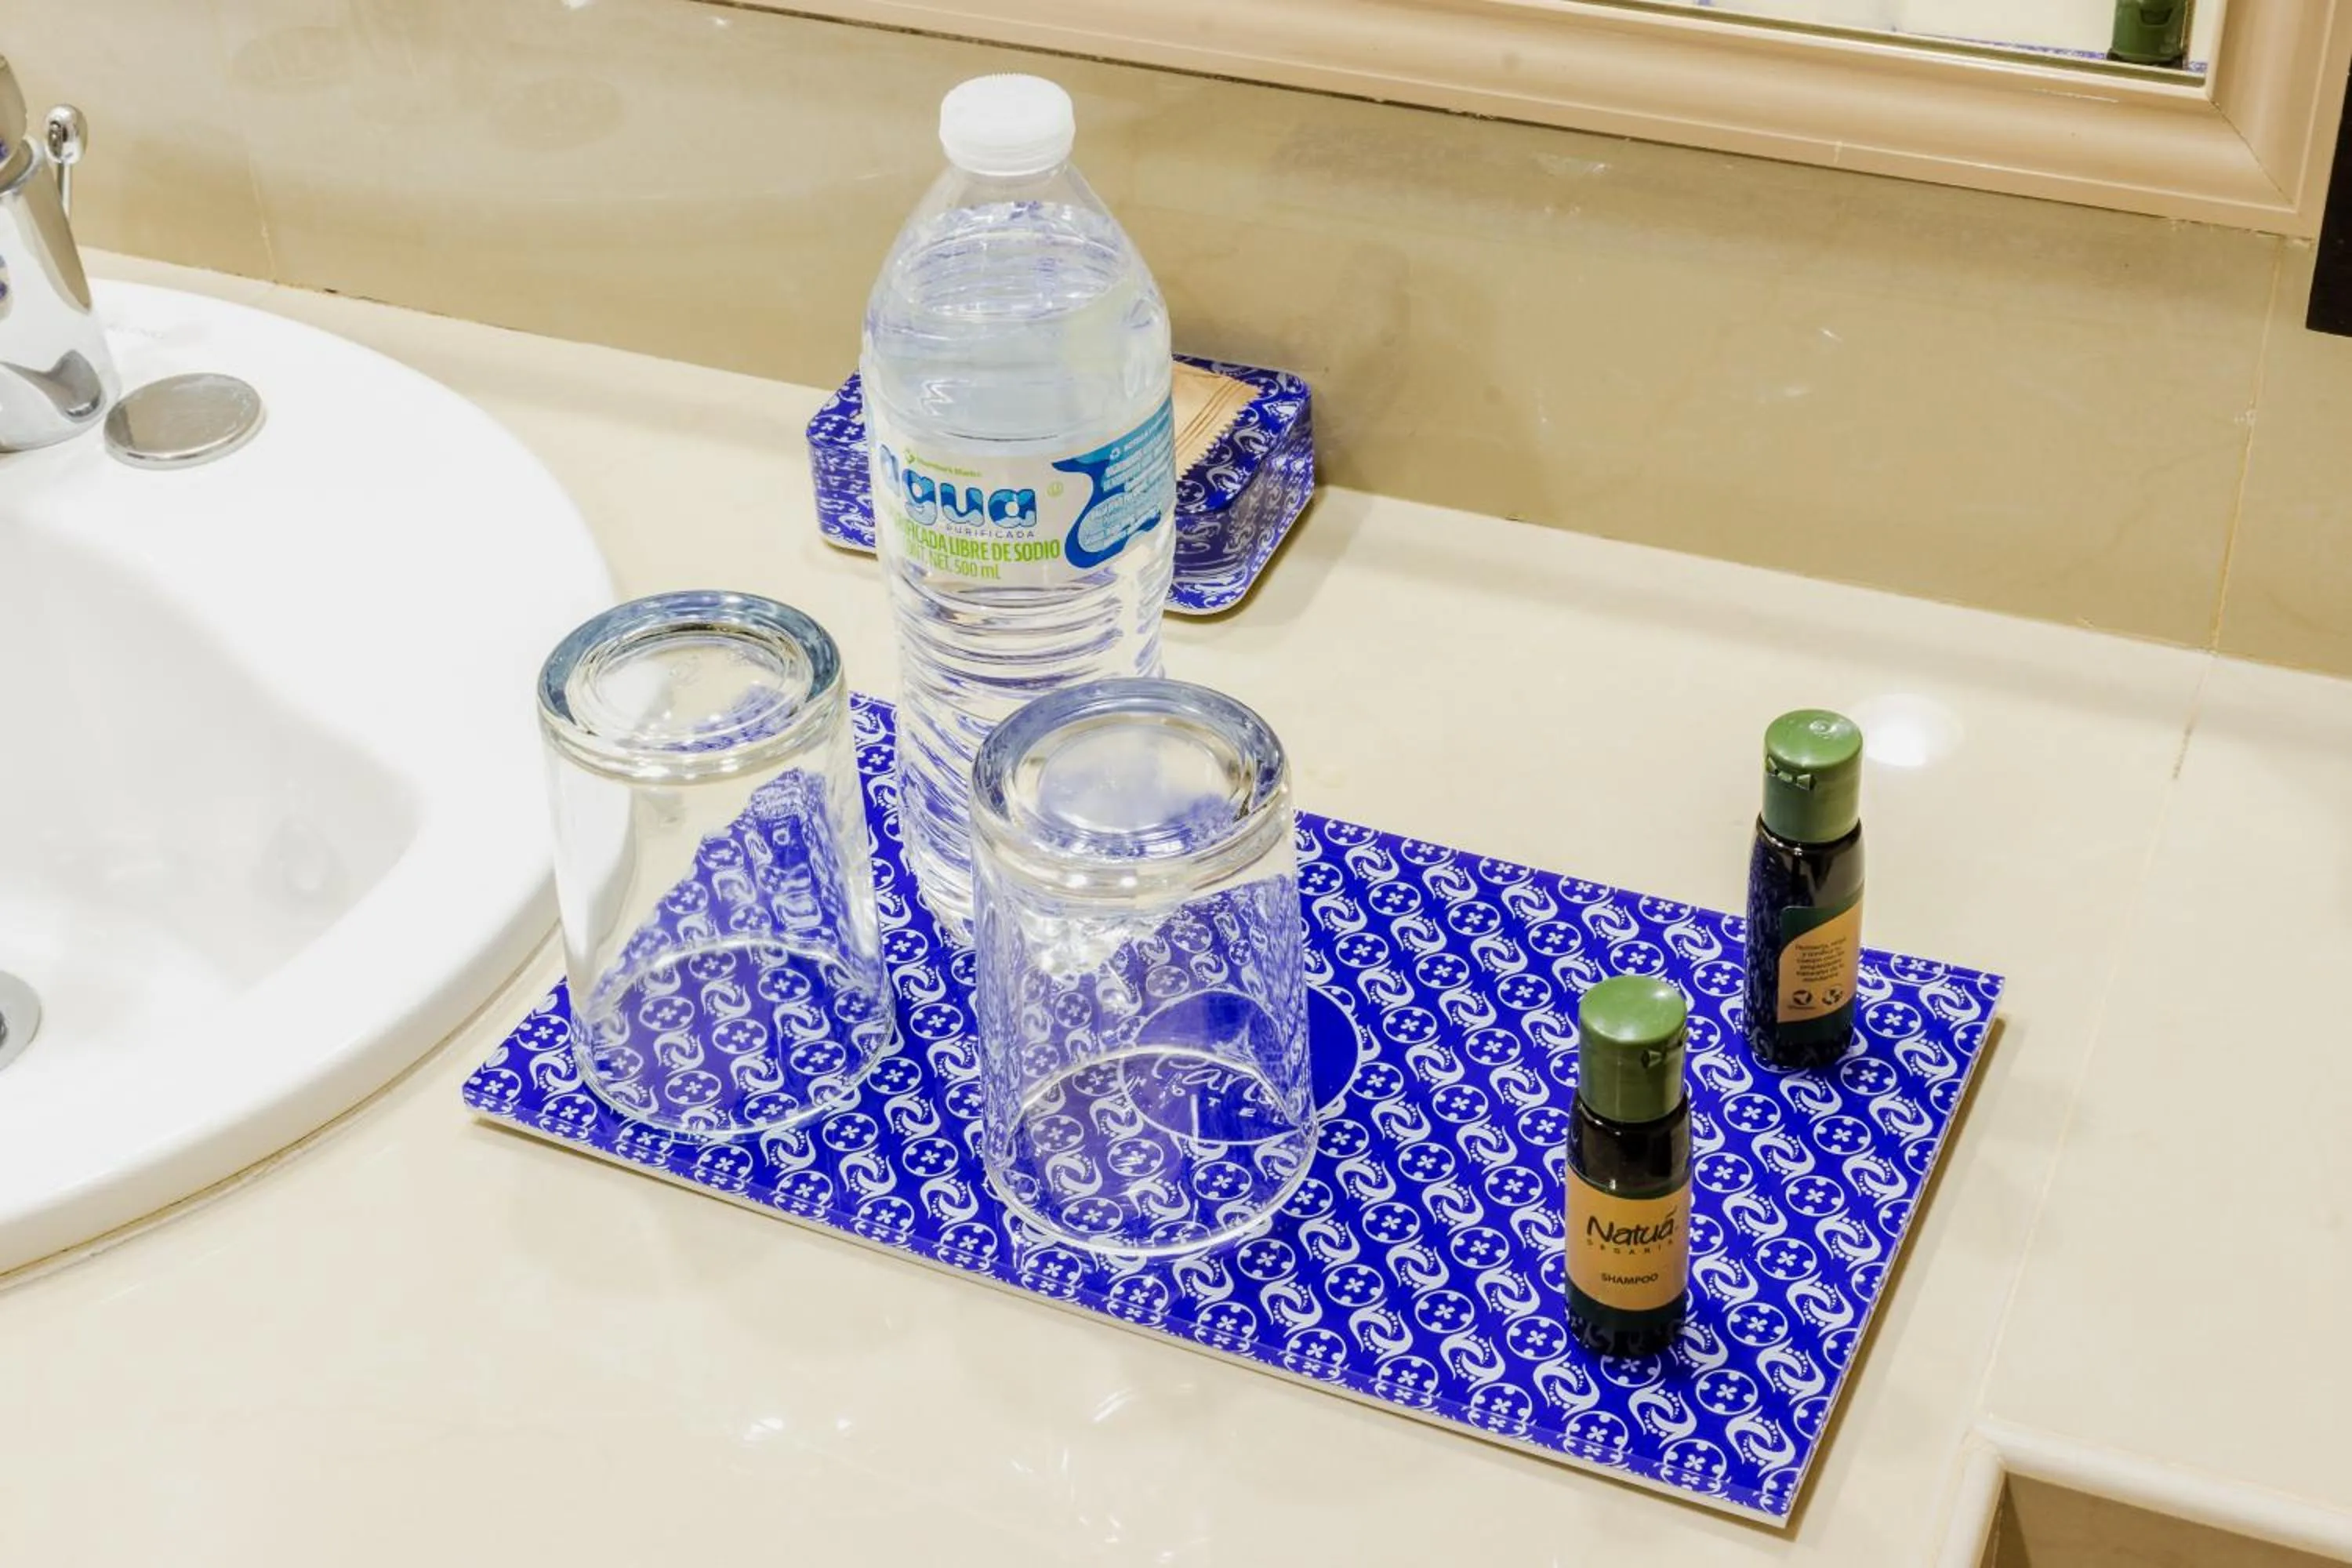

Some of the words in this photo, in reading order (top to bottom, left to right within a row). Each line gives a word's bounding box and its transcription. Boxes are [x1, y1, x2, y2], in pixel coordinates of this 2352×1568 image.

[946, 525, 1036, 539] PURIFICADA
[949, 536, 989, 560] LIBRE
[991, 542, 1011, 562] DE
[1014, 539, 1061, 562] SODIO
[954, 559, 978, 578] 500
[1586, 1205, 1678, 1246] Natuá
[1601, 1272, 1659, 1285] SHAMPOO
